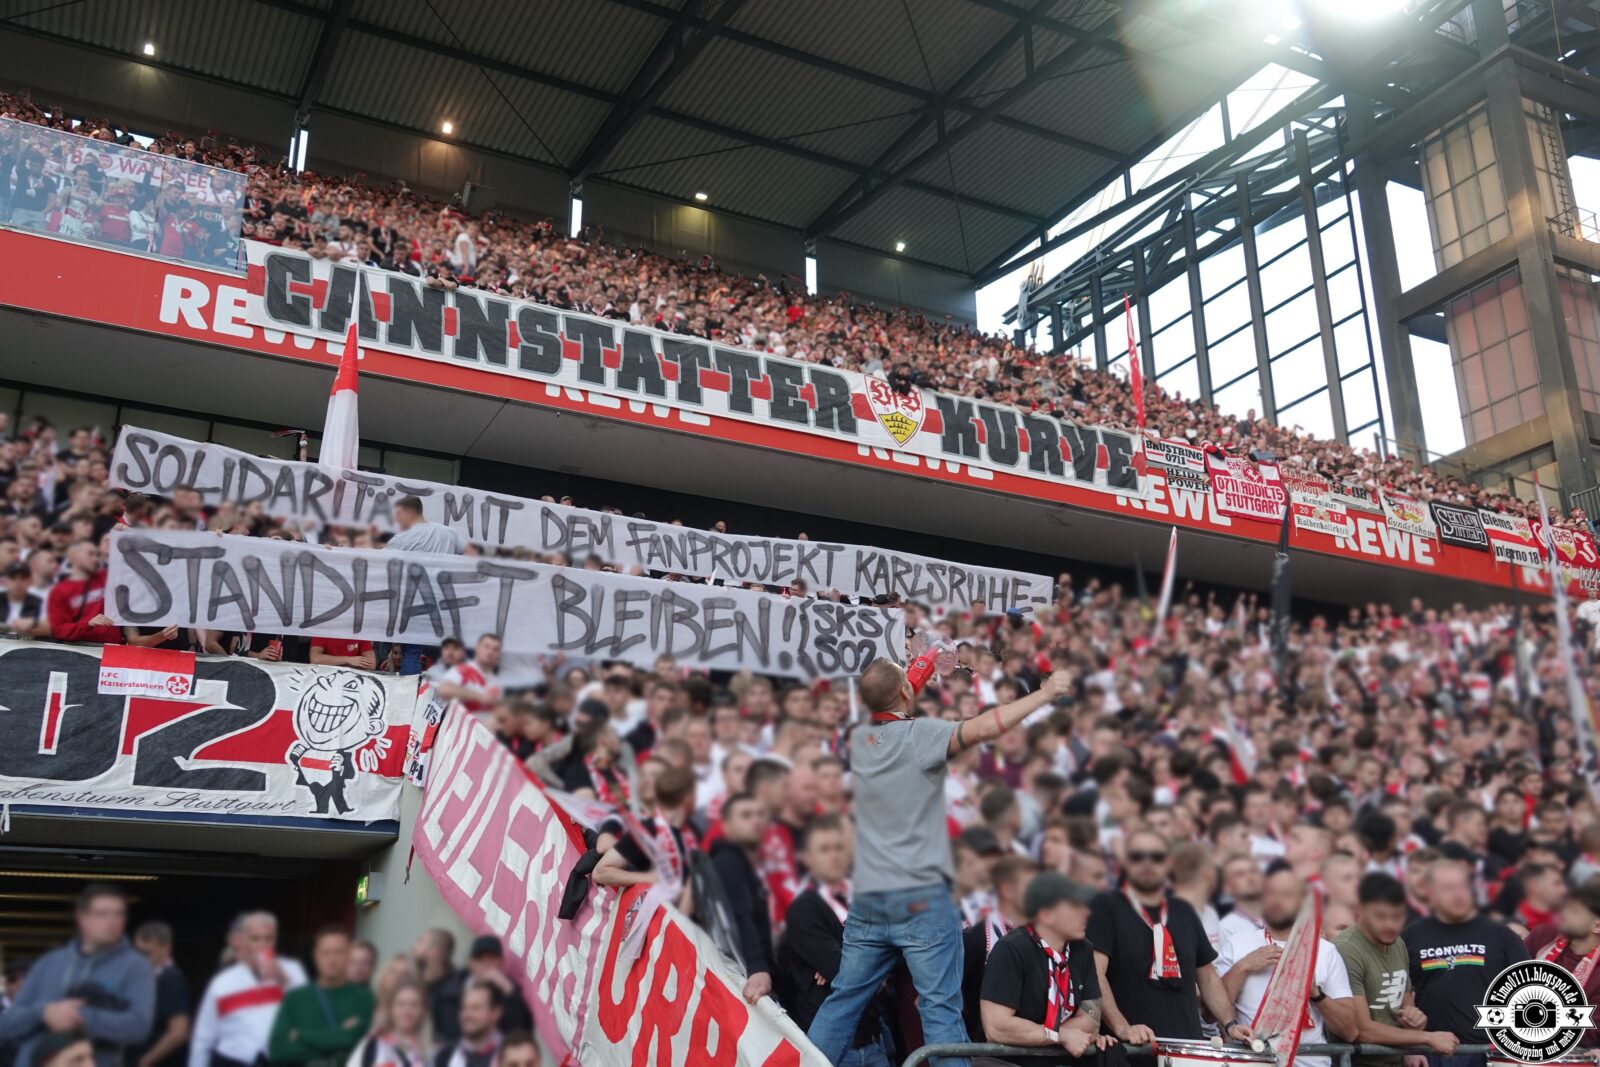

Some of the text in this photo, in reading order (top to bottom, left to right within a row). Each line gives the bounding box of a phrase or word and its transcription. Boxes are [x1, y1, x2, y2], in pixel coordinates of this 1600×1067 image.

[75, 149, 208, 190] BD WALSEE
[160, 274, 364, 360] RE
[264, 249, 859, 436] CANNSTATTER
[935, 394, 1139, 491] KURVE
[1165, 453, 1186, 465] 0711
[1168, 478, 1210, 492] POWER
[1217, 476, 1284, 501] 0711 ADDICTS
[1225, 492, 1280, 515] STUTTGART
[444, 491, 524, 545] MIT
[541, 506, 614, 558] DEM
[625, 522, 846, 587] FANPROJEKT
[1528, 551, 1540, 565] 18
[115, 534, 539, 650] STANDHAFT
[154, 791, 297, 815] Stuttgart
[1420, 944, 1486, 959] SCONVOLTS
